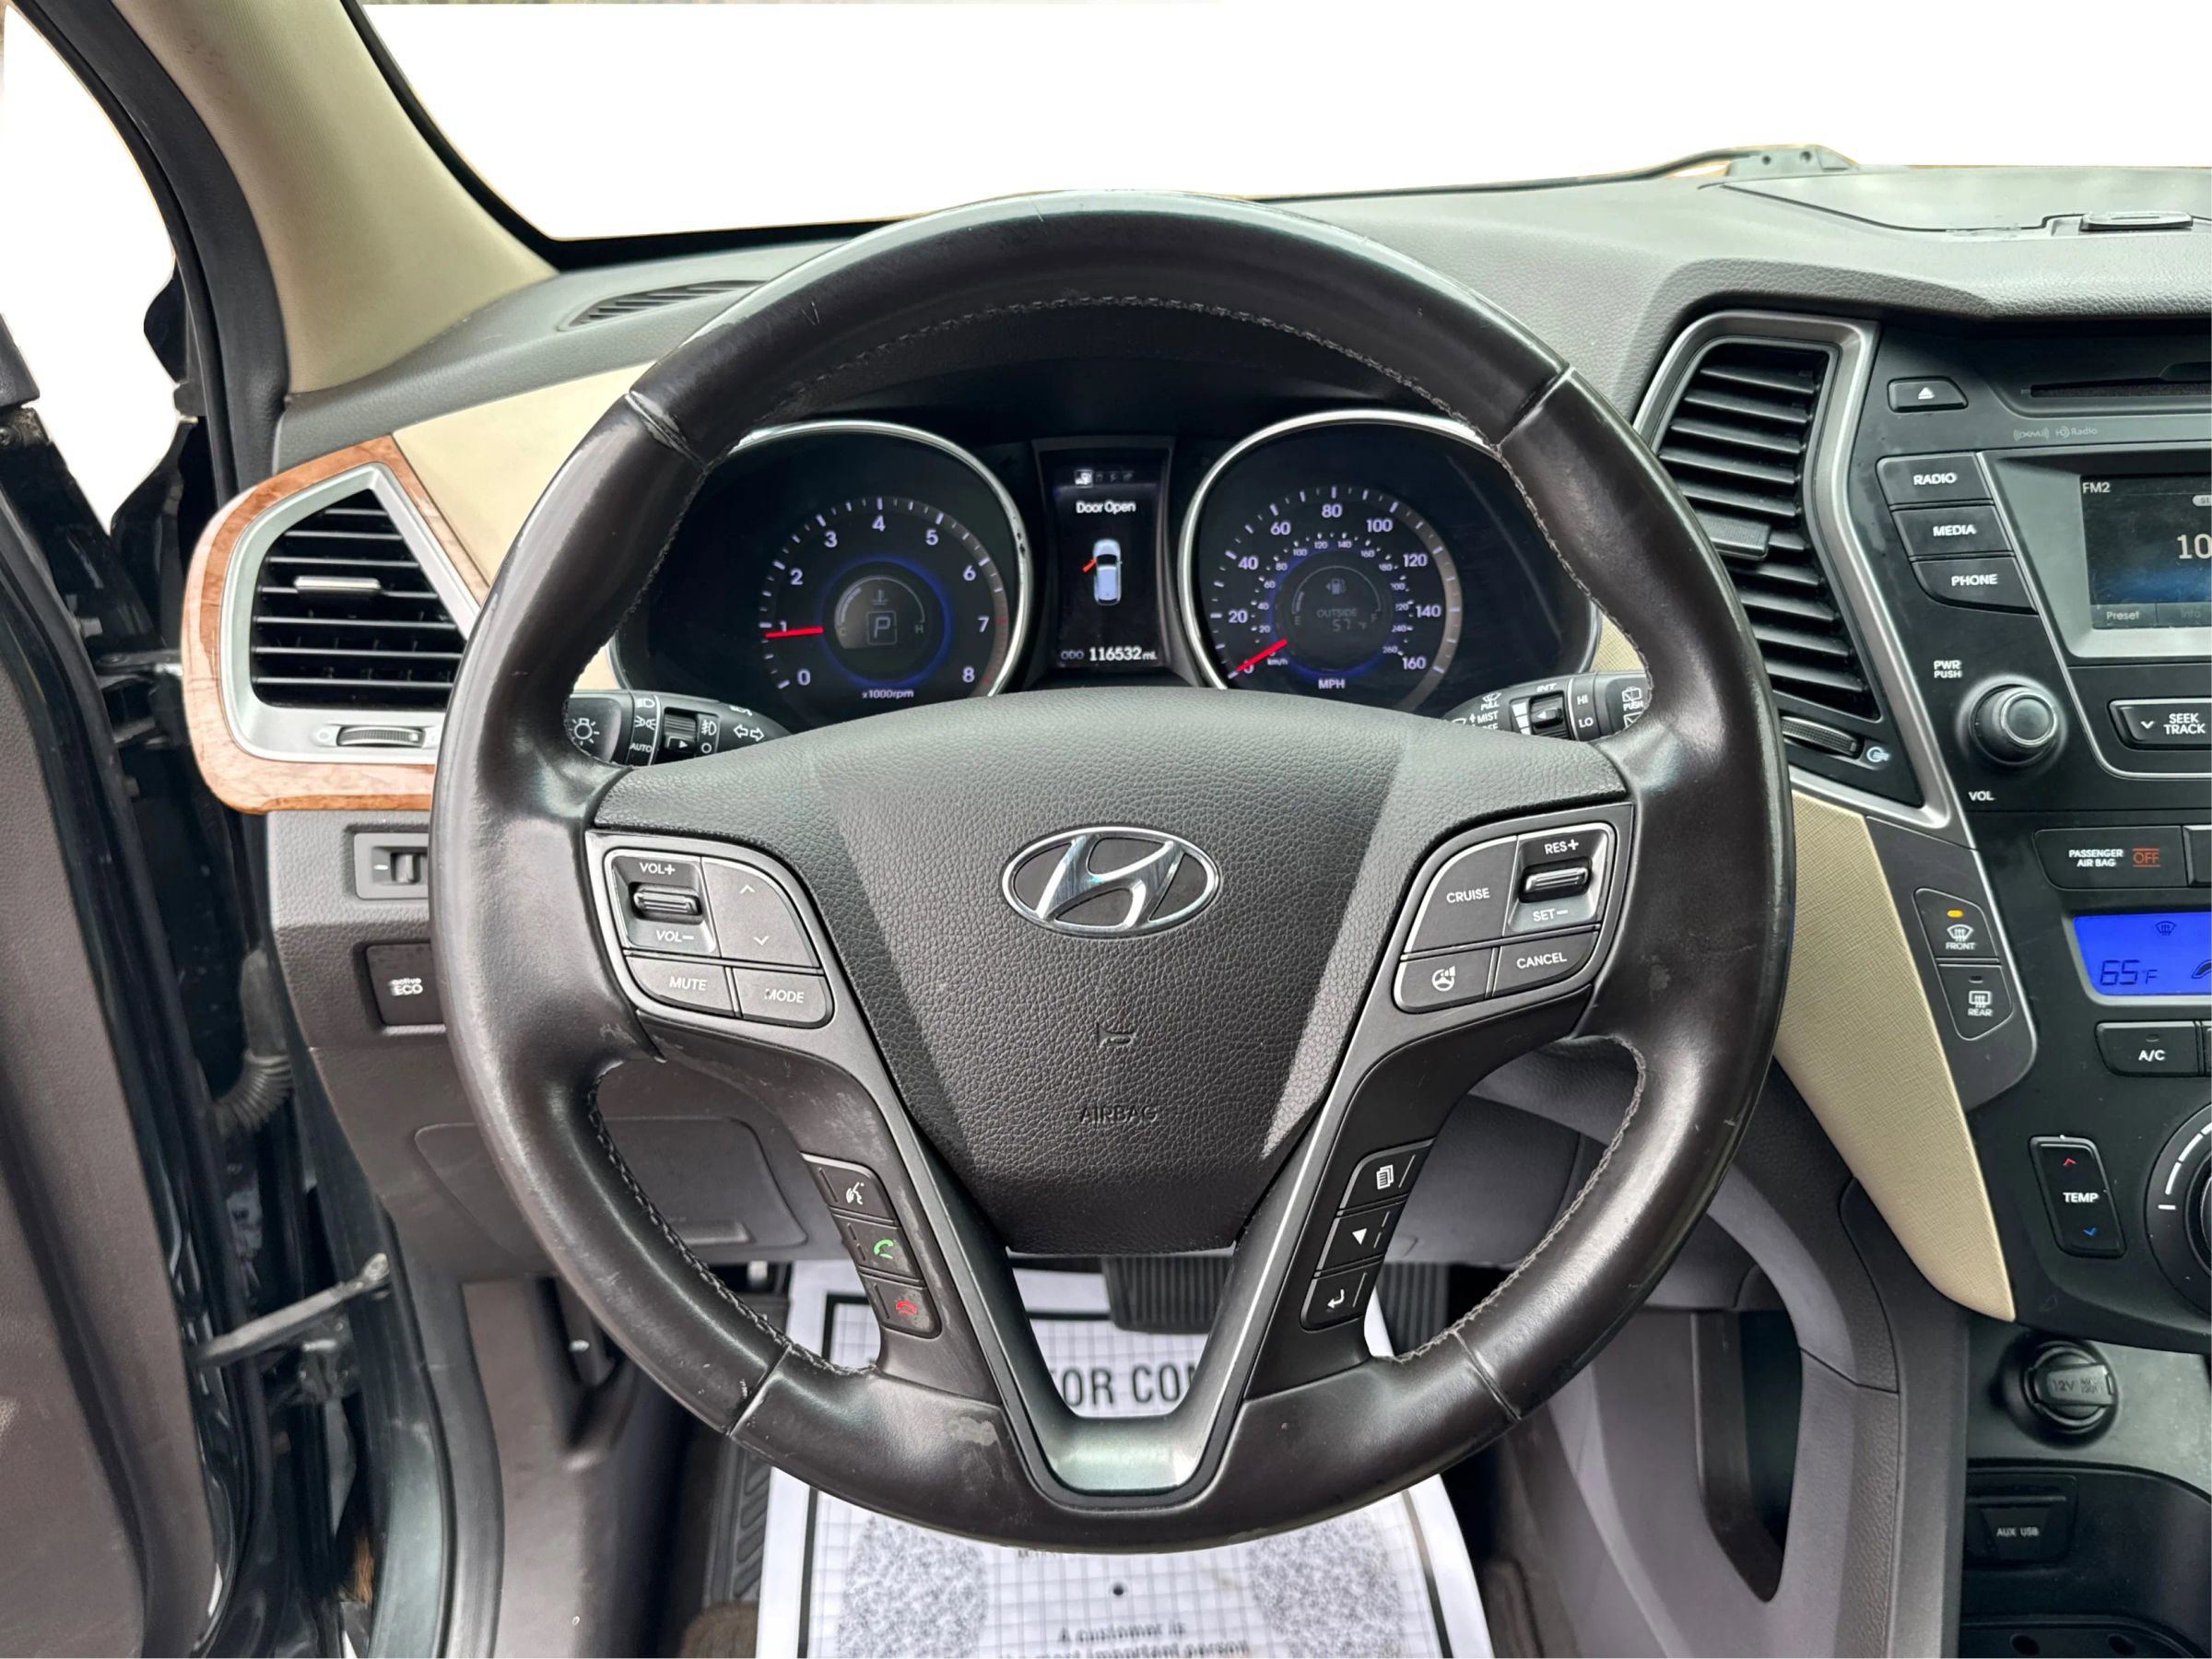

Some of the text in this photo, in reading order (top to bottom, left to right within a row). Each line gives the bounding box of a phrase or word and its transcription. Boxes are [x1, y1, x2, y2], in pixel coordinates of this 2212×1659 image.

[1913, 472, 1958, 486] RADIO
[2082, 481, 2111, 494] FM2
[1076, 500, 1136, 515] Door Open
[1321, 503, 1343, 518] 80
[872, 515, 886, 532] 4
[1270, 521, 1290, 535] 60
[1366, 518, 1393, 533] 100
[1933, 524, 1977, 536] MEDIA
[824, 531, 838, 547] 3
[925, 529, 939, 546] 5
[1337, 539, 1352, 549] 140
[1313, 540, 1328, 550] 120
[1292, 548, 1307, 557] 100
[1238, 556, 1259, 570] 40
[1275, 562, 1288, 571] 80
[1403, 553, 1428, 568] 120
[790, 569, 804, 584] 2
[962, 564, 976, 581] 6
[1264, 580, 1276, 589] 60
[1951, 573, 1998, 587] PHONE
[1257, 602, 1269, 610] 40
[1415, 604, 1441, 618] 140
[1228, 609, 1248, 624] 20
[1316, 608, 1358, 618] OUTSIDE
[2106, 610, 2140, 621] Preset
[874, 616, 890, 639] P
[978, 616, 990, 632] 7
[1258, 624, 1271, 633] 20
[1332, 618, 1351, 632] 57
[1060, 650, 1085, 661] ODO
[1088, 646, 1142, 662] 116532
[1402, 656, 1427, 670] 160
[1934, 660, 1962, 670] PWR
[796, 669, 811, 686] 0
[962, 666, 976, 683] 8
[1934, 670, 1963, 679] PUSH
[1318, 678, 1346, 689] MPH
[862, 688, 915, 700] x1000rpm
[1577, 694, 1589, 706] HI
[1623, 700, 1644, 712] PUSH
[1477, 711, 1500, 724] MIST
[1579, 716, 1594, 729] LO
[2169, 712, 2199, 724] SEEK
[2163, 724, 2206, 735] TRACK
[629, 742, 653, 754] AUTO
[1969, 791, 1995, 801] VOL
[1544, 839, 1579, 854] RES+
[2068, 848, 2124, 859] PASSENGER
[2132, 851, 2159, 864] OFF
[2077, 857, 2116, 867] AIR BAG
[639, 862, 676, 876] VOL+
[1446, 888, 1490, 903] CRUISE
[1945, 941, 1976, 950] FRONT
[1516, 951, 1568, 969] CANCEL
[391, 983, 424, 996] ECO
[669, 976, 708, 992] MUTE
[764, 987, 805, 1004] MODE
[1968, 1007, 1993, 1017] REAR
[2138, 1050, 2166, 1061] A/C
[1079, 1107, 1159, 1124] AIRBAG
[2063, 1192, 2100, 1204] TEMP
[1050, 1367, 1113, 1406] OR
[1996, 1526, 2039, 1536] AUX USB
[1077, 1624, 1162, 1643] customer
